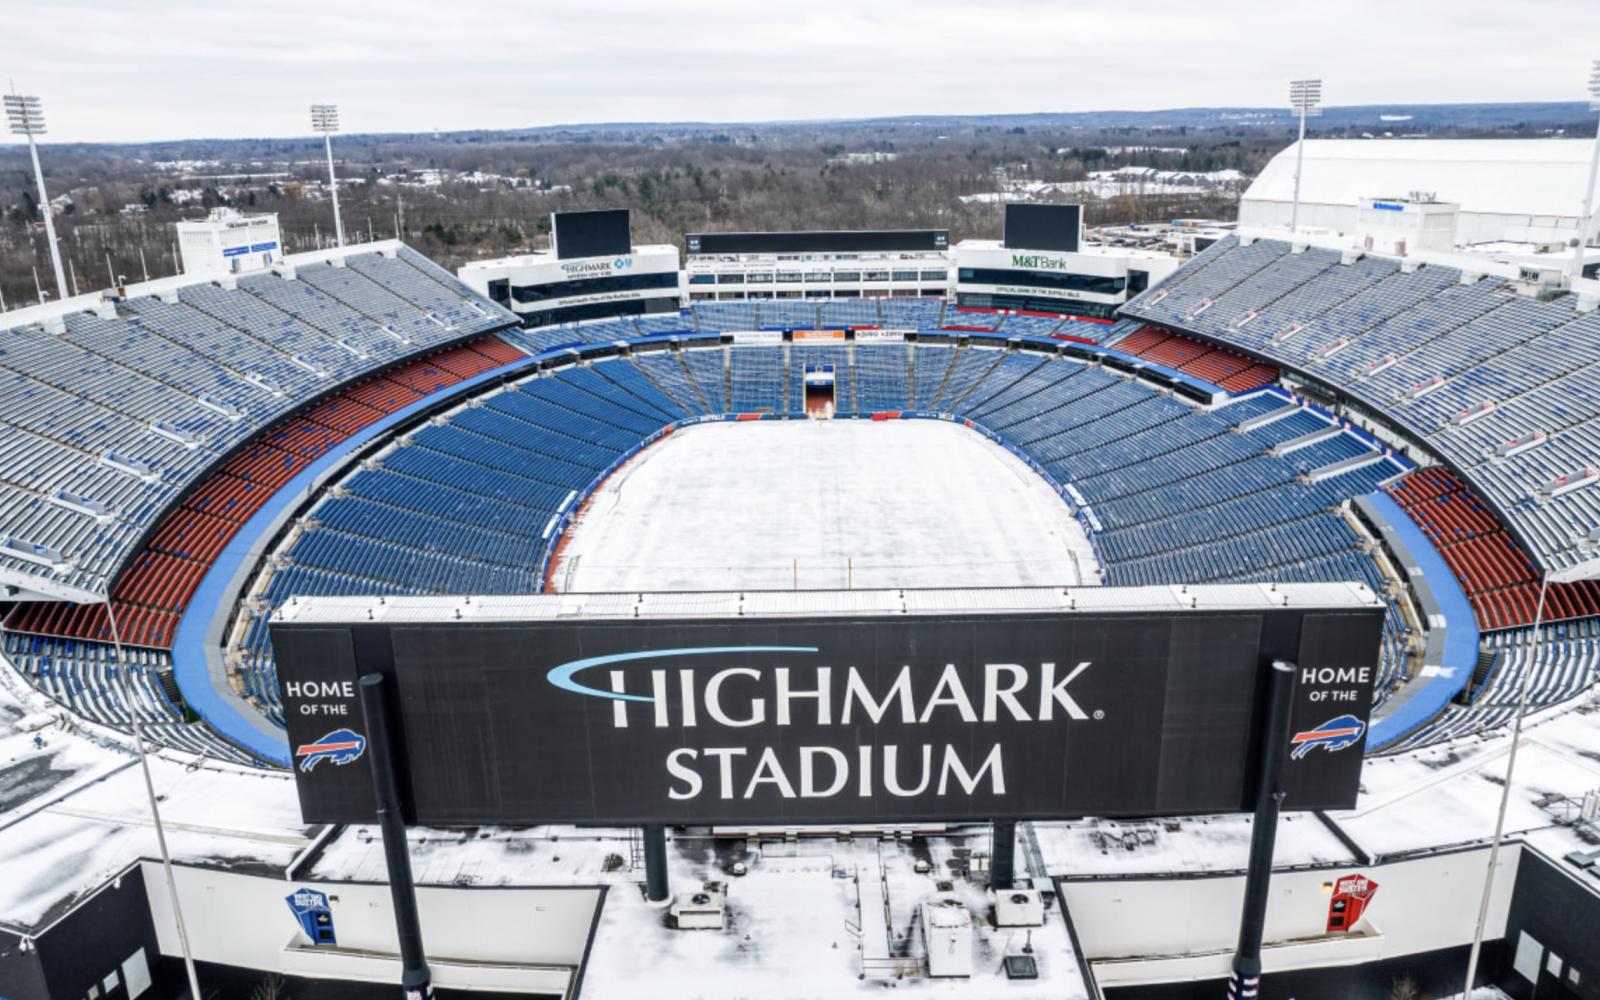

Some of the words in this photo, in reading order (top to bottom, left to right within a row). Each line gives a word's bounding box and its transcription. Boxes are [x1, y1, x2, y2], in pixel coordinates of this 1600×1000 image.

[565, 262, 612, 273] HIGHMARK
[1012, 254, 1040, 268] M&T
[1040, 256, 1067, 270] Bank
[1301, 667, 1370, 684] HOME
[286, 681, 355, 698] HOME
[609, 662, 1092, 728] HIGHMARK
[1309, 691, 1329, 702] OF
[1332, 690, 1357, 701] THE
[300, 704, 318, 715] OF
[321, 704, 348, 715] THE
[666, 743, 1006, 800] STADIUM
